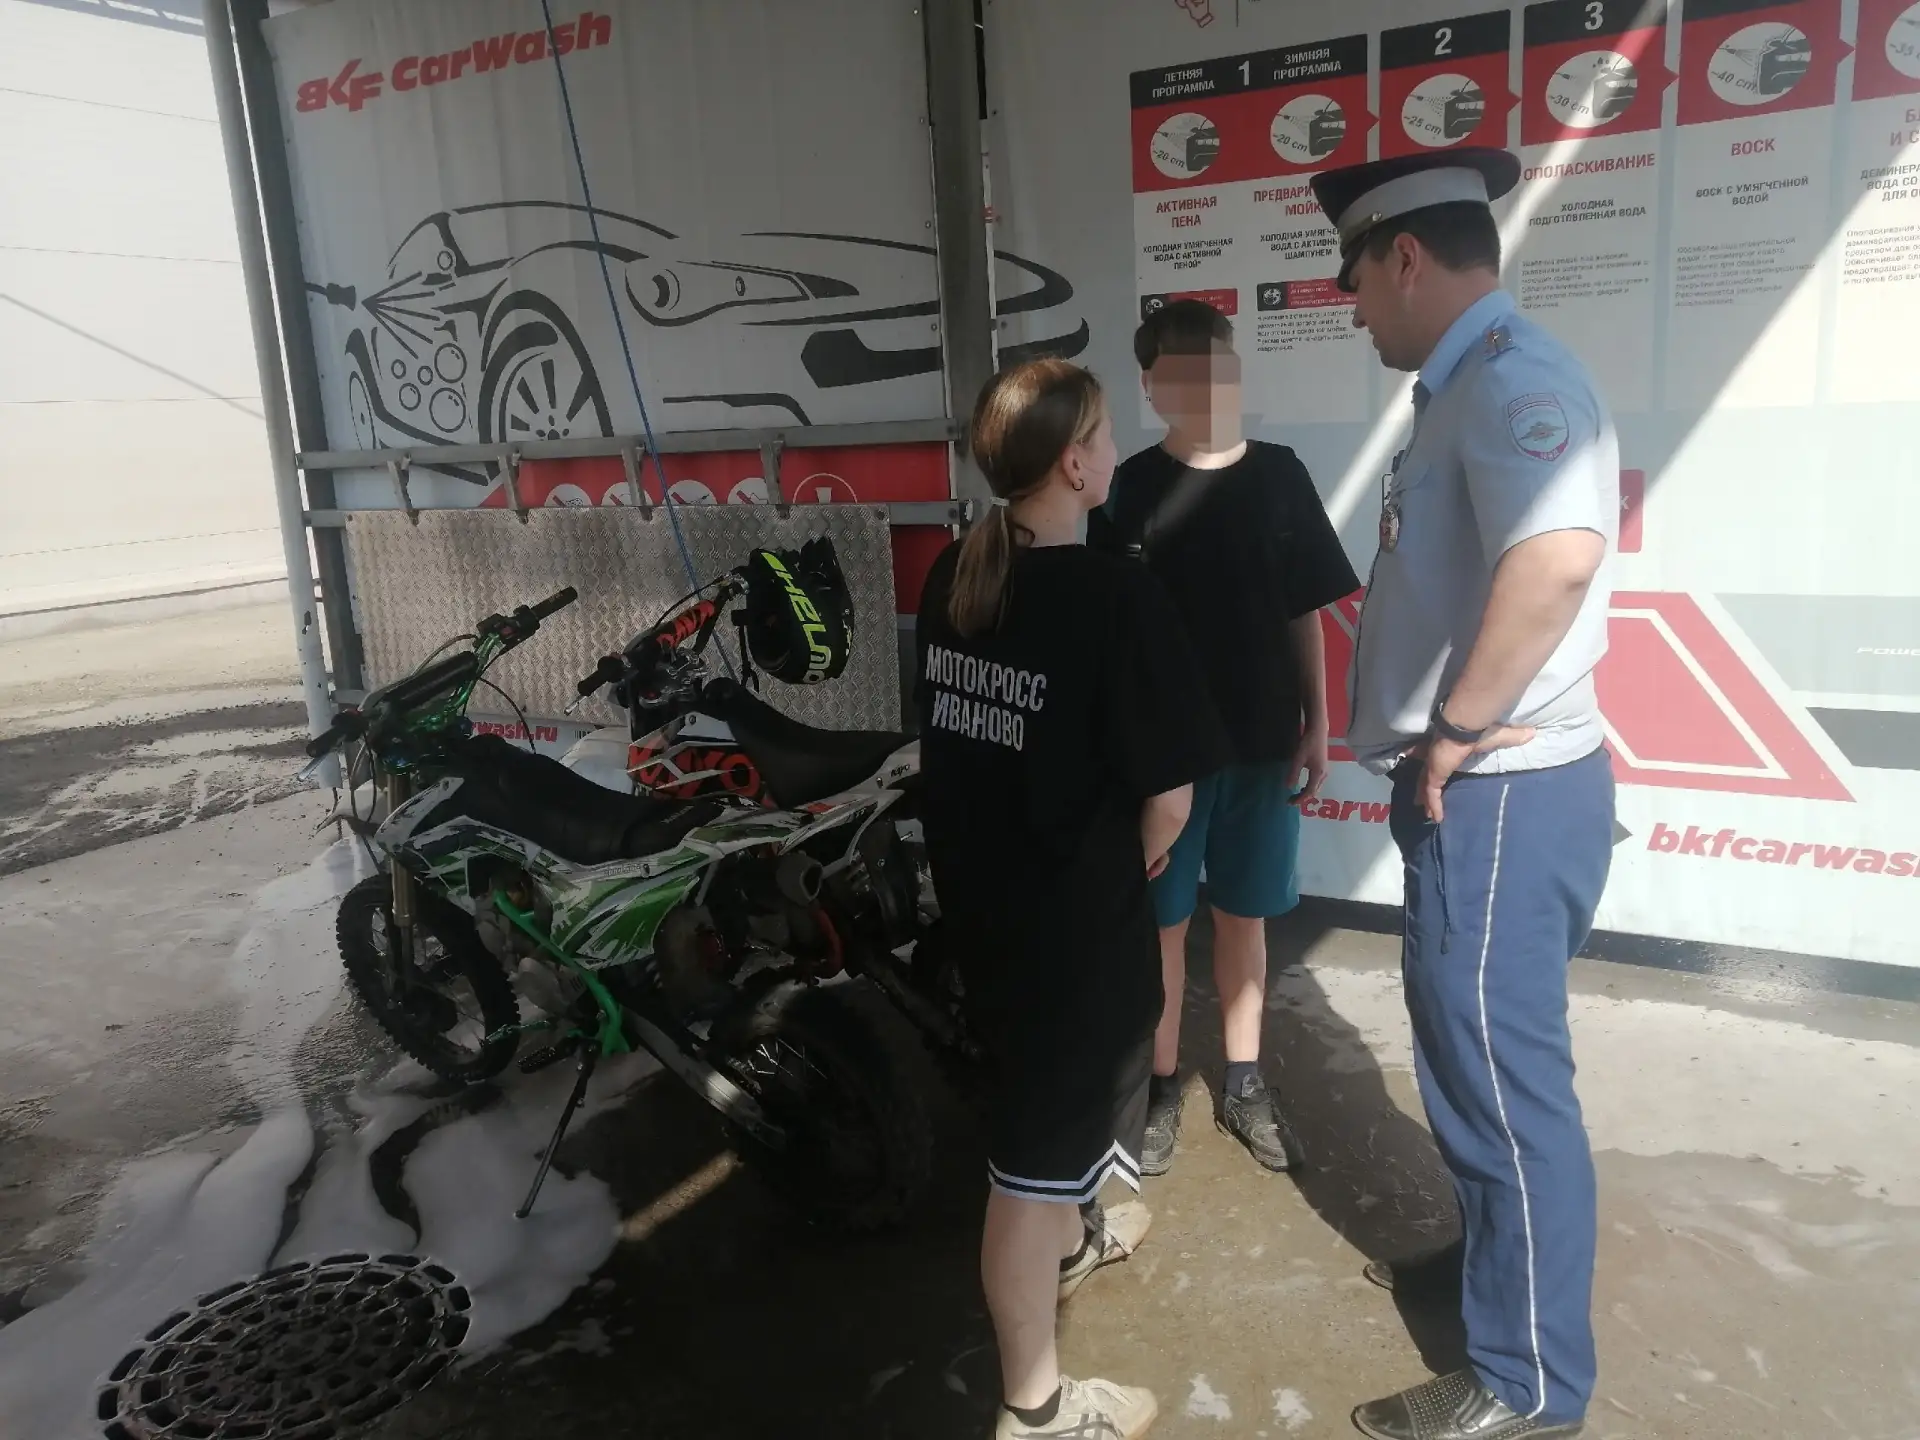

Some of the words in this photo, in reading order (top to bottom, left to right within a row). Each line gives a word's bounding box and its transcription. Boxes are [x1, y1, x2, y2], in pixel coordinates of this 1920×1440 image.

[1584, 1, 1605, 31] 3
[1434, 27, 1452, 56] 2
[1284, 48, 1330, 65] ЗИМНЯЯ
[1163, 68, 1204, 84] ЛЕТНЯЯ
[1238, 60, 1250, 87] 1
[1273, 60, 1342, 81] ПРОГРАММА
[1152, 80, 1215, 98] ПРОГРАММА
[1736, 78, 1757, 93] cm
[1571, 103, 1590, 115] cm
[1424, 123, 1442, 136] cm
[1291, 140, 1308, 153] cm
[1731, 138, 1776, 156] ВОСК
[1890, 131, 1902, 146] И
[1170, 154, 1185, 168] cm
[1523, 154, 1656, 181] ОПОЛАСКИВАНИЕ
[1696, 186, 1722, 198] ВОСК
[1726, 185, 1733, 195] С
[1736, 175, 1809, 193] УМЯГЧЕННОЙ
[1867, 179, 1899, 191] ВОДА
[1902, 176, 1918, 187] СО
[1254, 186, 1314, 203] ПРЕДВАРИ
[1732, 193, 1769, 207] ВОДОЙ
[1882, 188, 1908, 202] ДЛЯ
[1156, 196, 1217, 214] АКТИВНАЯ
[1561, 199, 1614, 213] ХОЛОДНАЯ
[1171, 214, 1202, 229] ПЕНА
[1529, 208, 1616, 228] ПОДГОТОВЛЕННАЯ
[1619, 206, 1647, 218] ВОДА
[1260, 229, 1304, 243] ХОЛОДНАЯ
[1143, 243, 1182, 255] ХОЛОДНАЯ
[1183, 237, 1233, 251] УМЯГЧЕННАЯ
[1154, 250, 1175, 262] ВОДА
[1175, 250, 1181, 260] С
[1182, 247, 1222, 260] АКТИВНОЙ
[1270, 241, 1292, 252] ВОДА
[1294, 240, 1301, 250] С
[1284, 248, 1333, 261] ШАМПУНЕМ
[925, 643, 1047, 712] МОТОКРОСС
[932, 690, 1024, 752] ИВАНОВО
[472, 720, 558, 742] wash.ru
[1647, 822, 1920, 878] bkfcarwas
